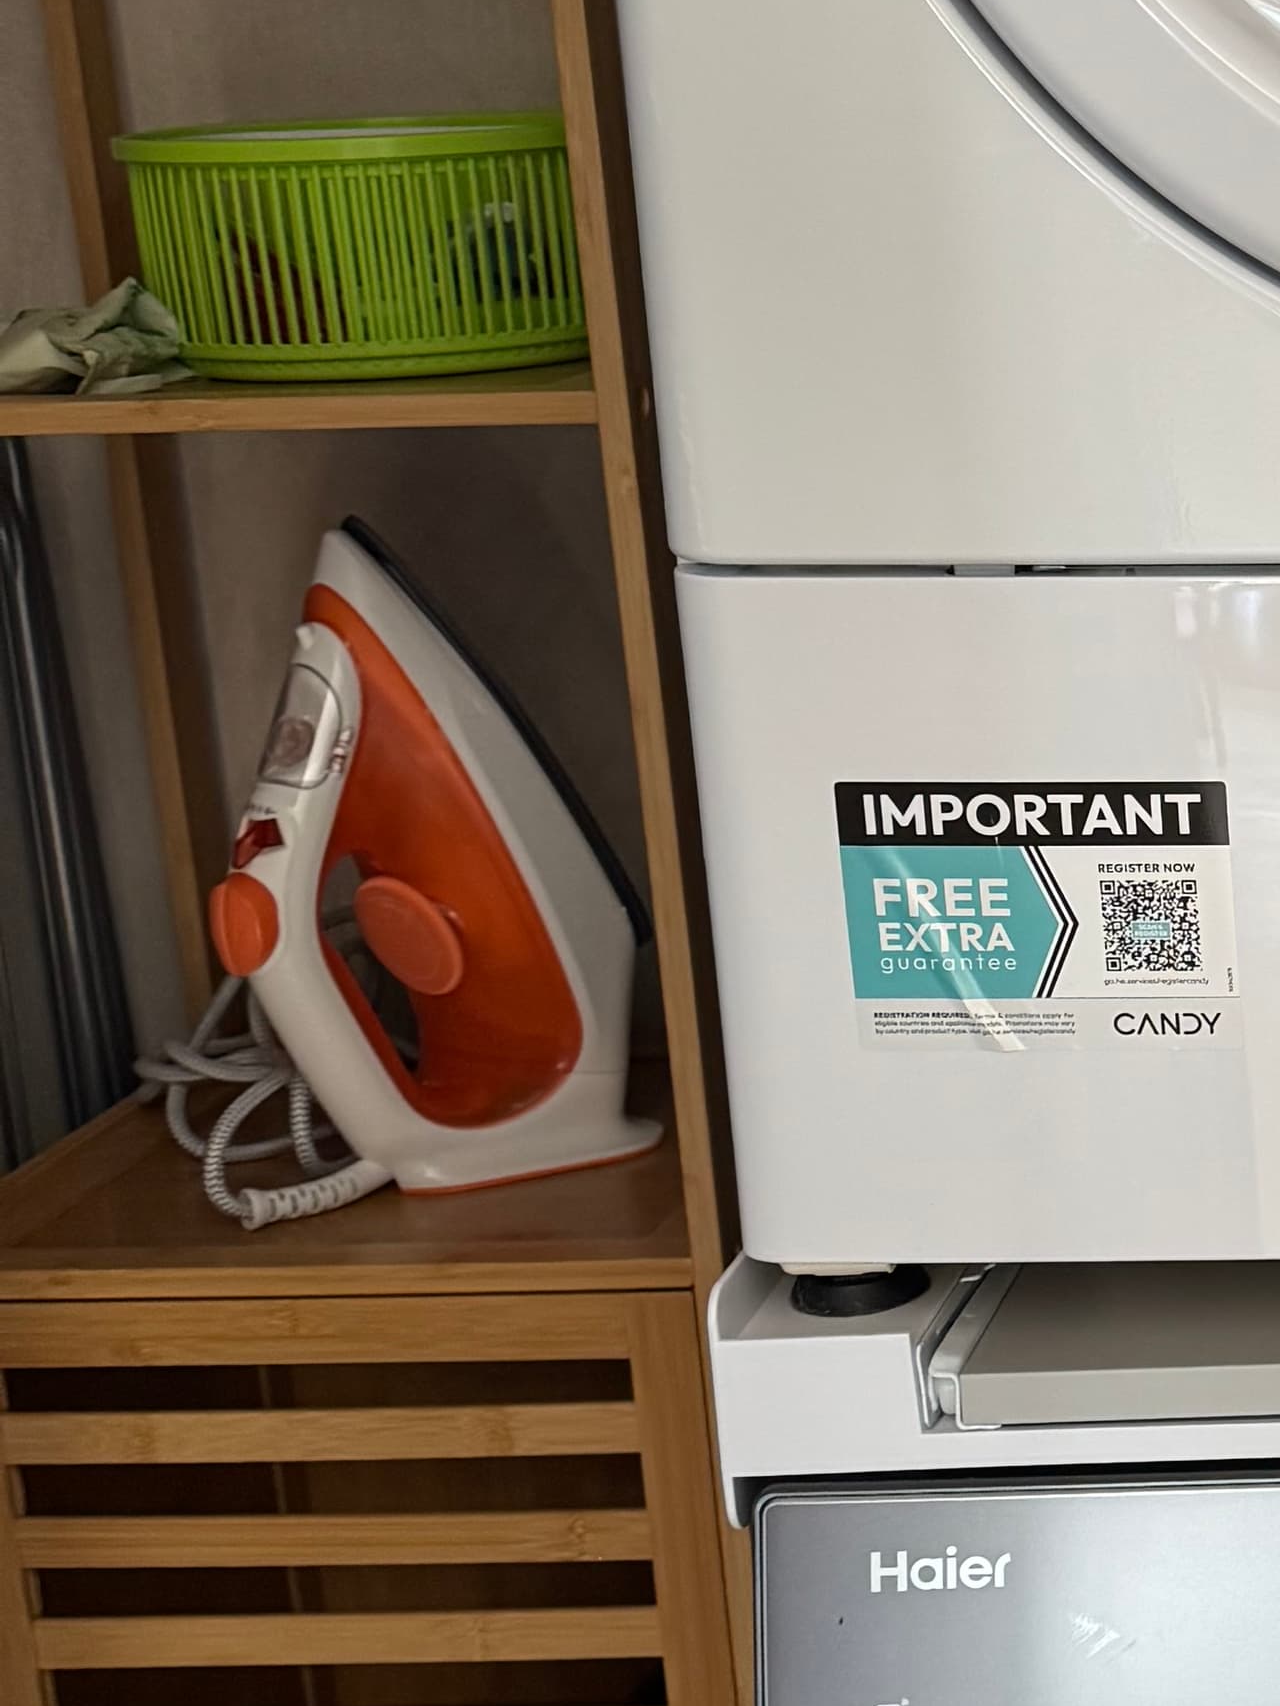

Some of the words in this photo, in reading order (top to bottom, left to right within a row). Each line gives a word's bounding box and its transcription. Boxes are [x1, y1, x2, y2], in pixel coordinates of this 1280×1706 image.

[862, 793, 1202, 837] IMPORTANT
[1098, 863, 1160, 874] REGISTER
[1163, 863, 1195, 873] NOW
[872, 878, 1011, 918] FREE
[879, 922, 1015, 952] EXTRA
[880, 953, 1018, 974] guarantee
[1113, 1012, 1222, 1036] CANDY
[869, 1545, 1012, 1593] Haier
